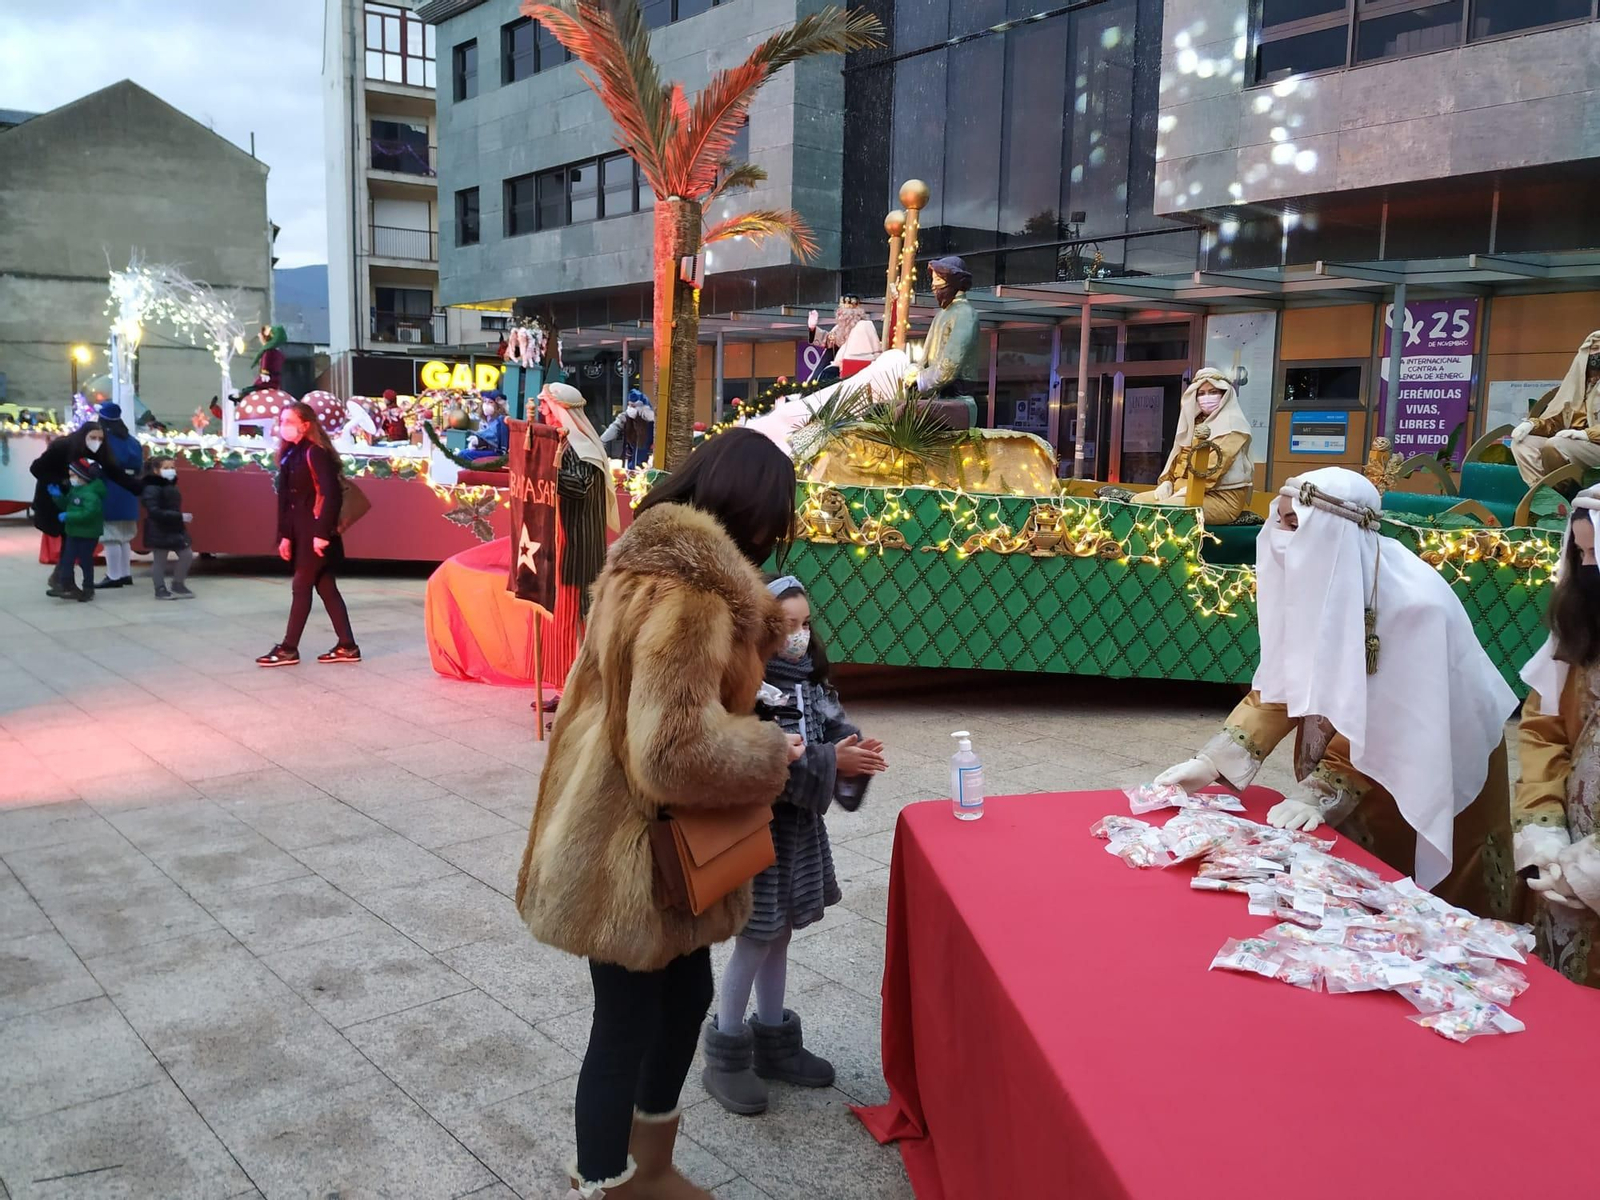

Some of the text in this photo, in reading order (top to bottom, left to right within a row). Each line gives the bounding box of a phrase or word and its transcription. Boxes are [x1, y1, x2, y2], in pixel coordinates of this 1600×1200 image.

[1429, 309, 1470, 339] 25
[1406, 357, 1462, 365] INTERNACIONAL
[1406, 404, 1440, 415] VIVAS,
[1399, 420, 1446, 429] LIBRES E
[1394, 434, 1449, 445] SEN MEDO
